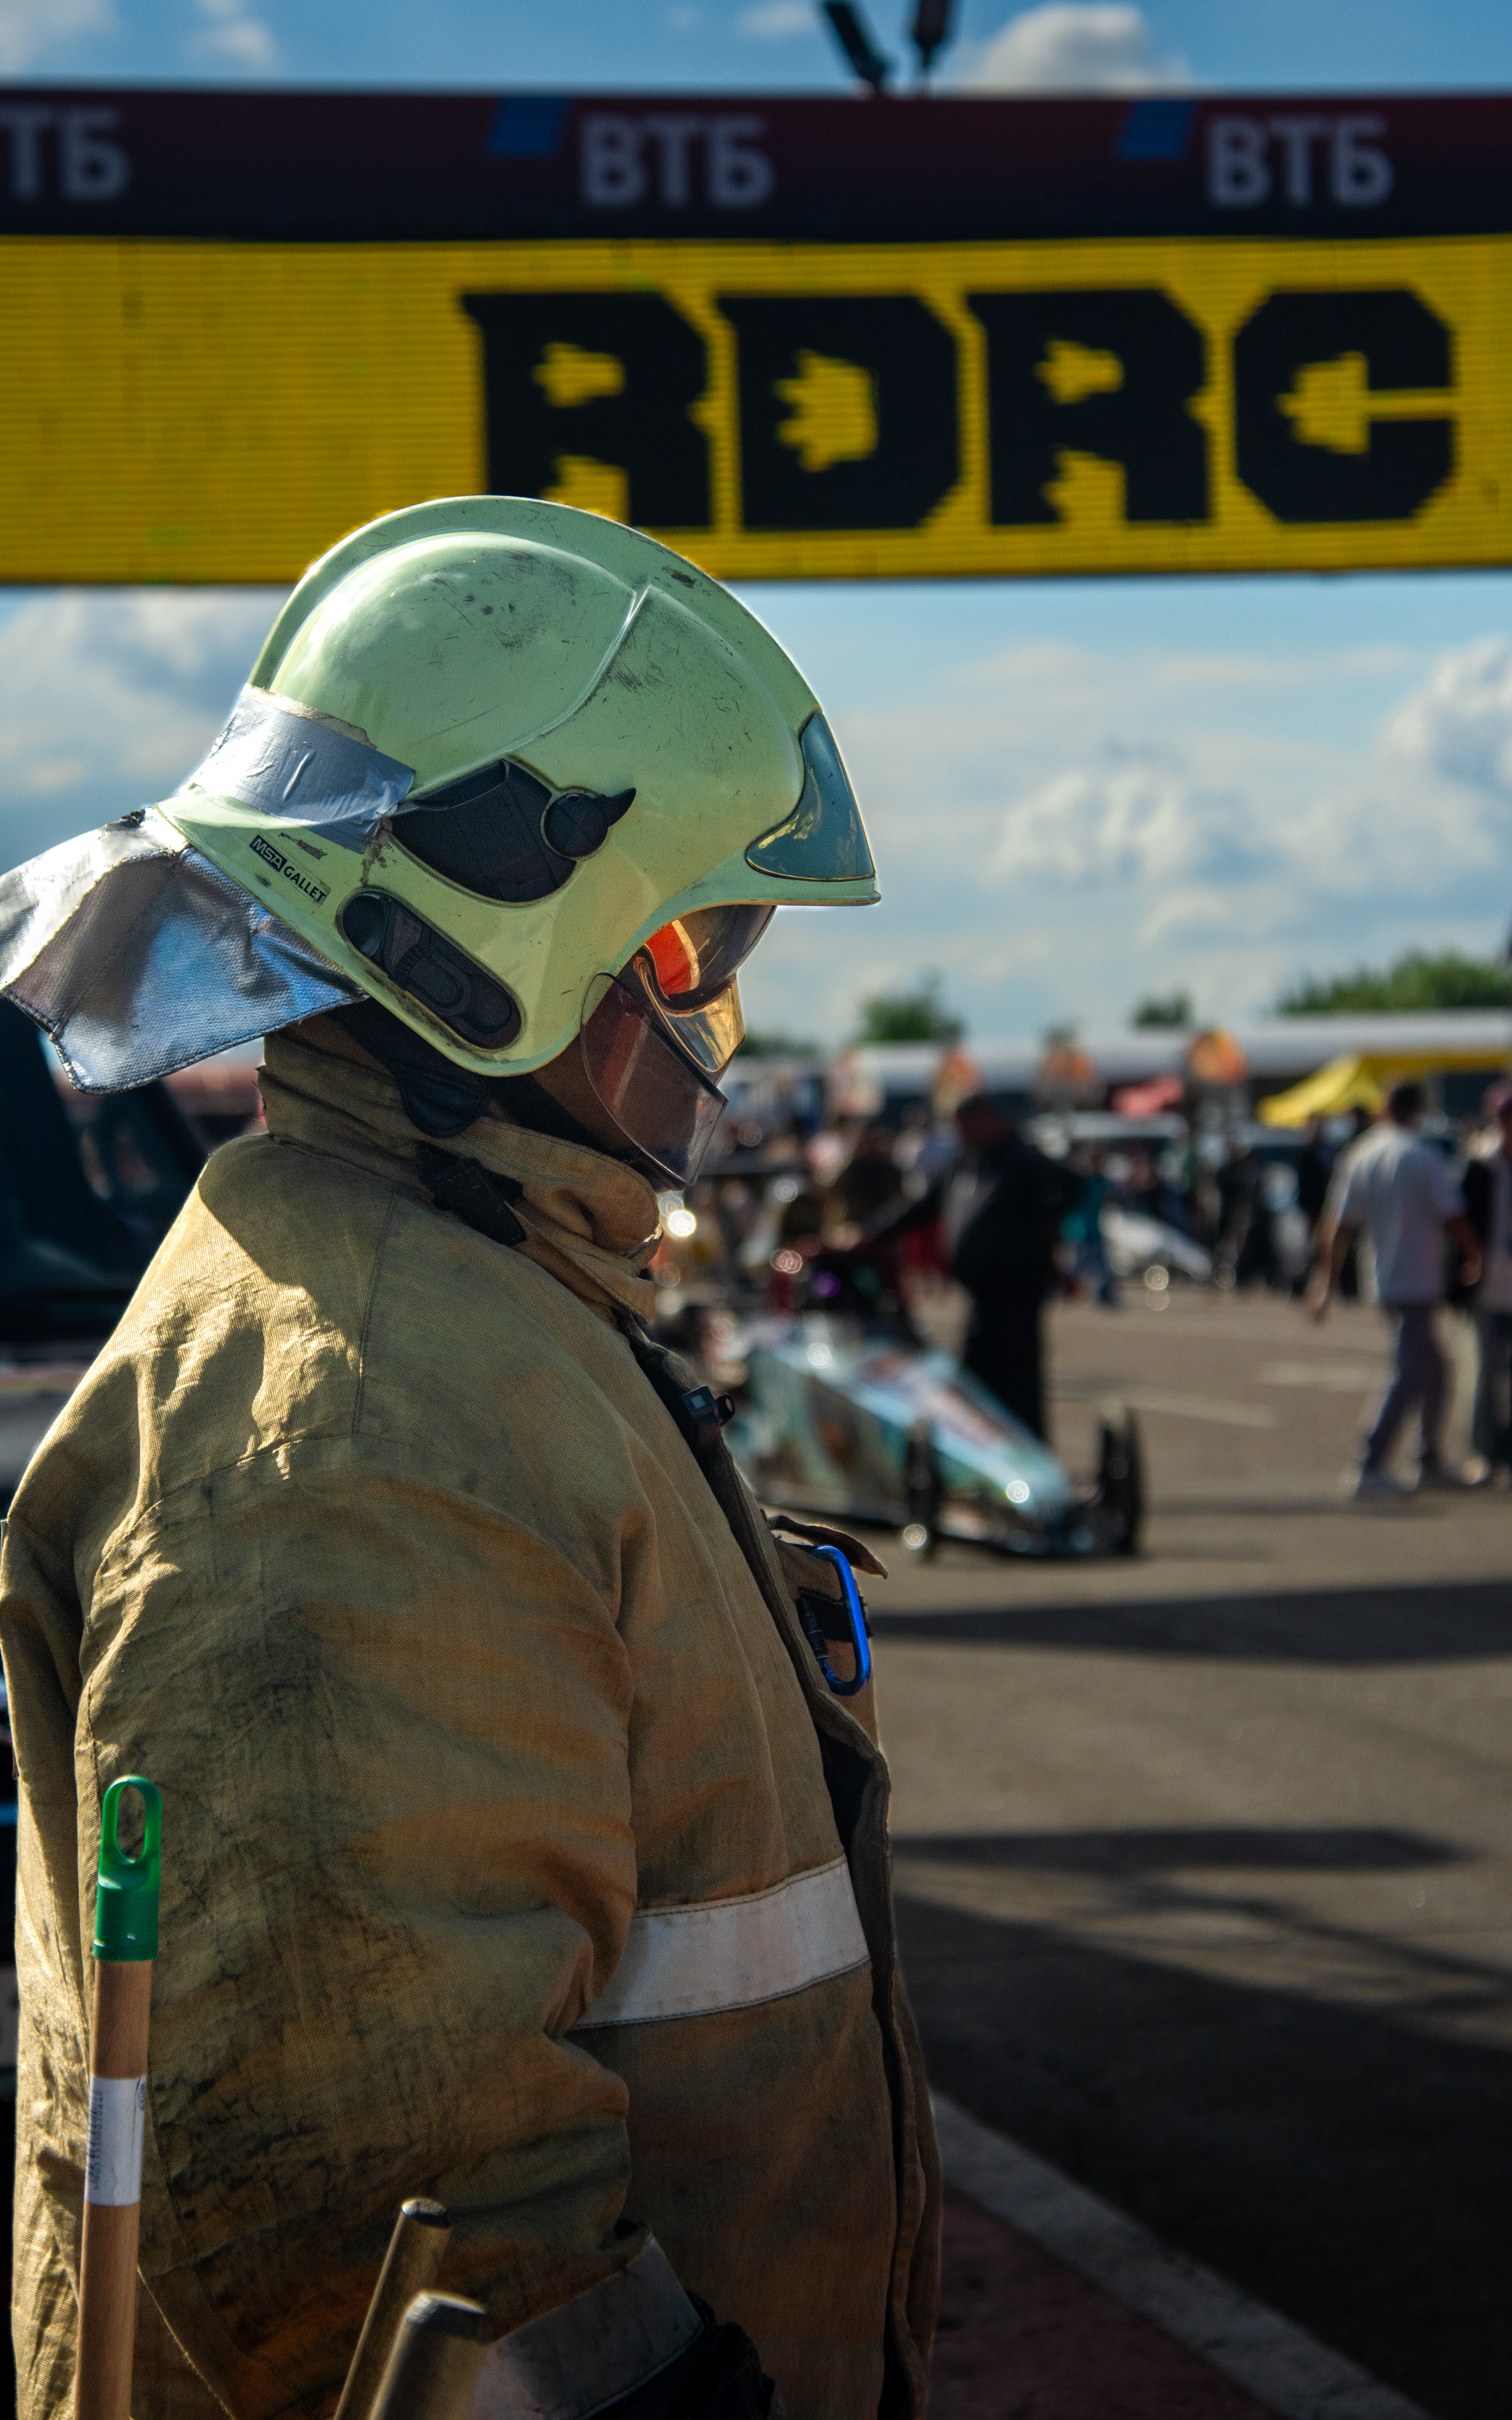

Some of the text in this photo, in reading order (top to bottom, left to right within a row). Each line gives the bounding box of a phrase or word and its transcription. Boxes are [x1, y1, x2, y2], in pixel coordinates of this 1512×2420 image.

[579, 113, 775, 208] ВТБ
[1206, 113, 1395, 209] ВТБ
[458, 287, 1458, 532] RDRC
[251, 838, 326, 902] MSA GALLET
